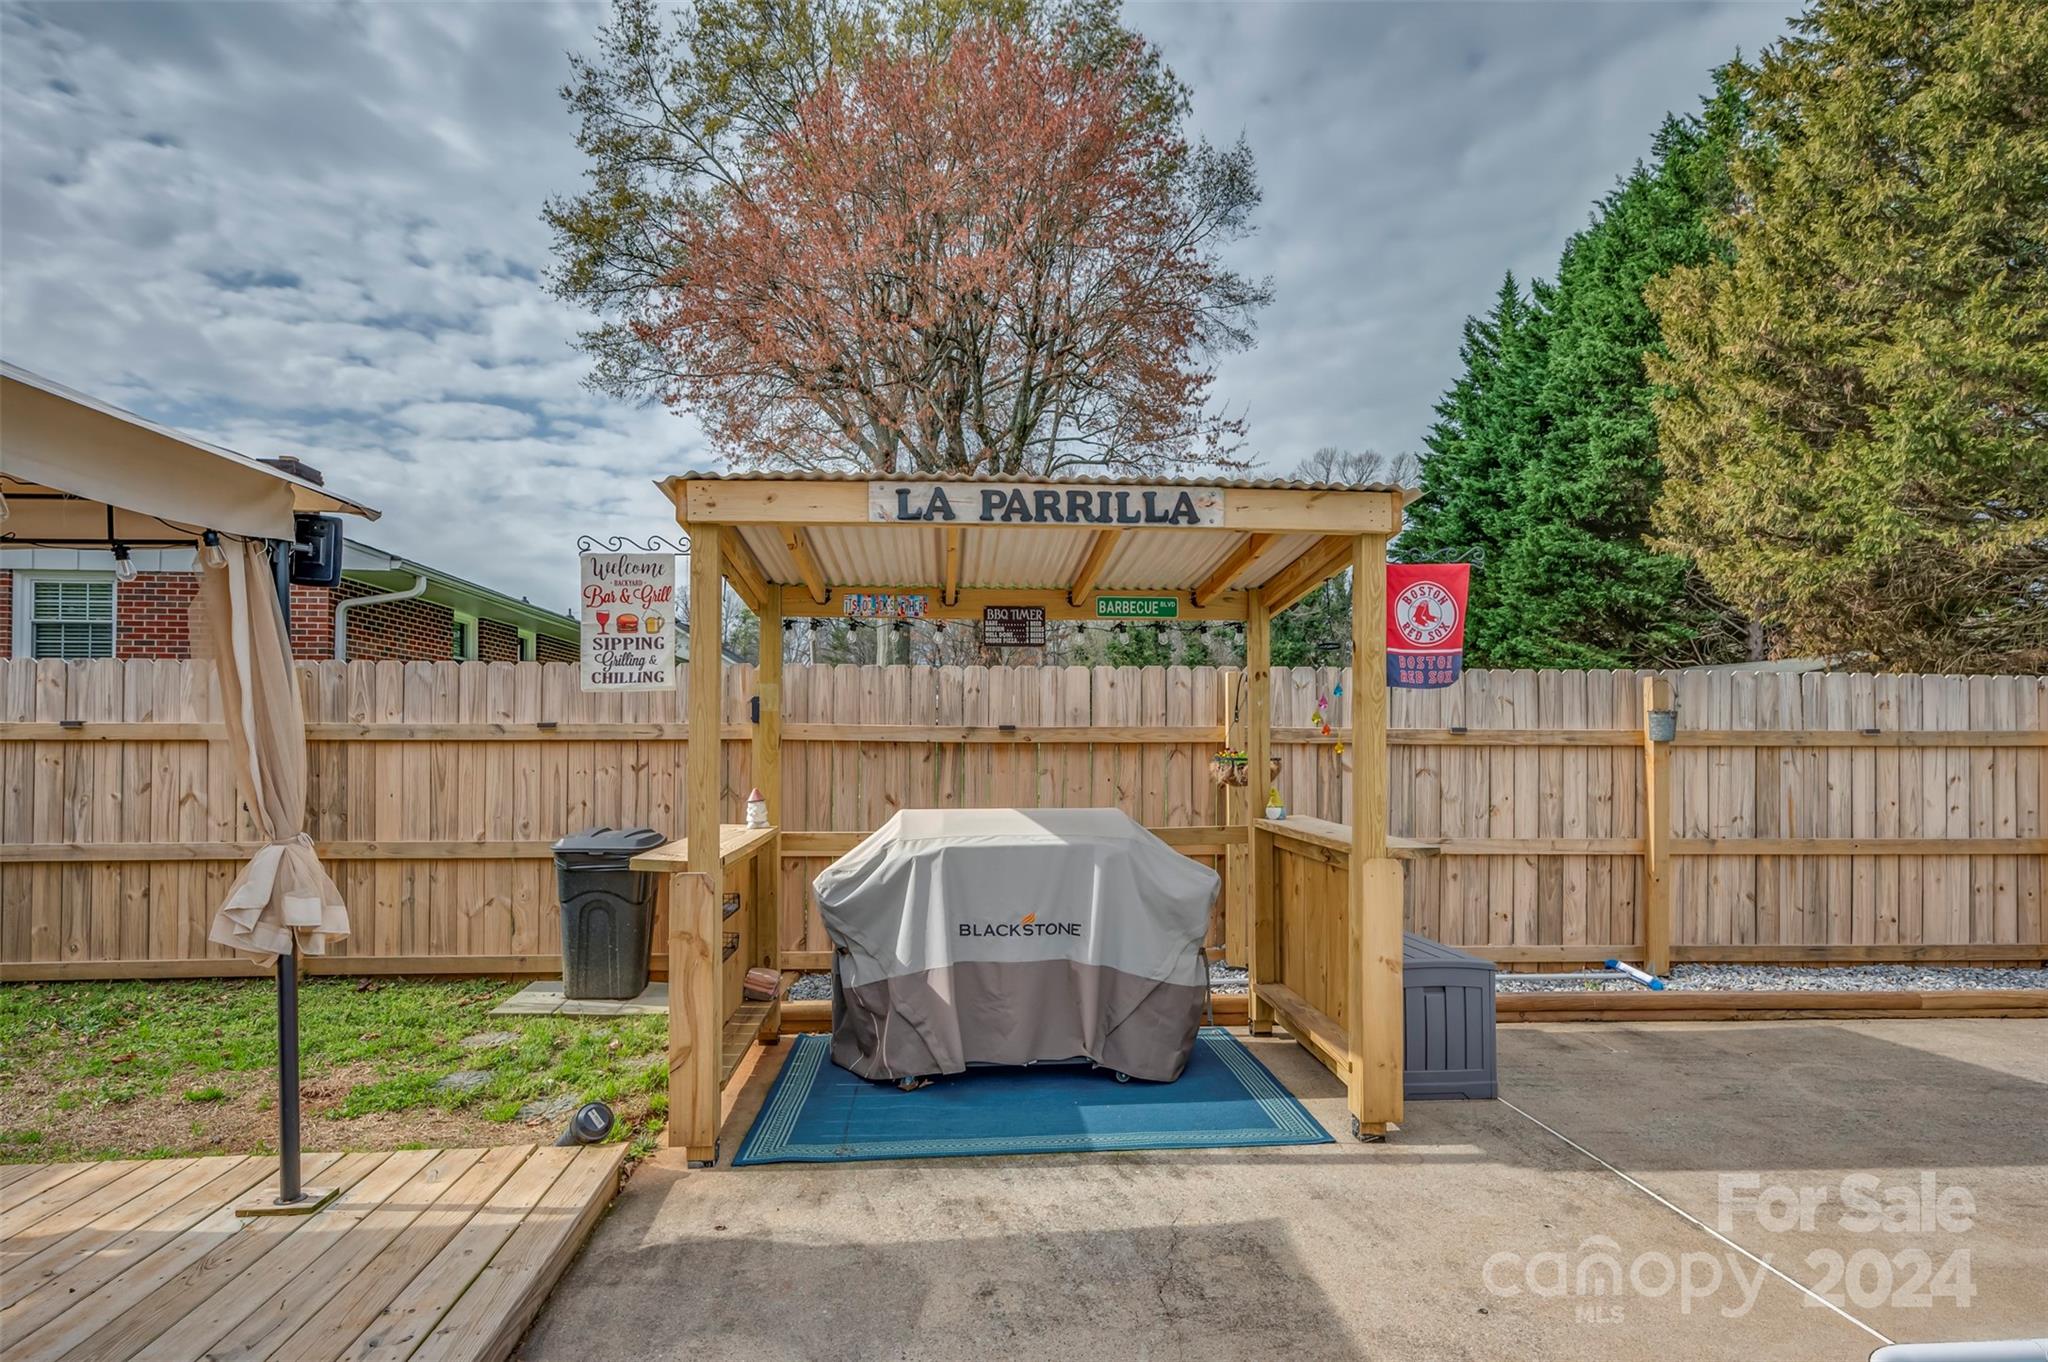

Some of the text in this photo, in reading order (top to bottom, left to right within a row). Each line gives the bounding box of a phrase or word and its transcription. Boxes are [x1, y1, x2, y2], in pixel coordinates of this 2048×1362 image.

[895, 486, 1200, 525] LA PARRILLA
[591, 554, 666, 581] Welcome
[583, 584, 672, 609] Bar & Grill
[1402, 586, 1449, 606] BOSTON
[987, 608, 1044, 620] BBQ TIMER
[1099, 600, 1159, 614] BARBECUE
[1402, 621, 1451, 641] RED SOX
[592, 636, 665, 651] SIPPING
[594, 650, 658, 672] Grilling &
[591, 670, 665, 685] CHILLING
[959, 923, 1082, 937] BLACKSTONE
